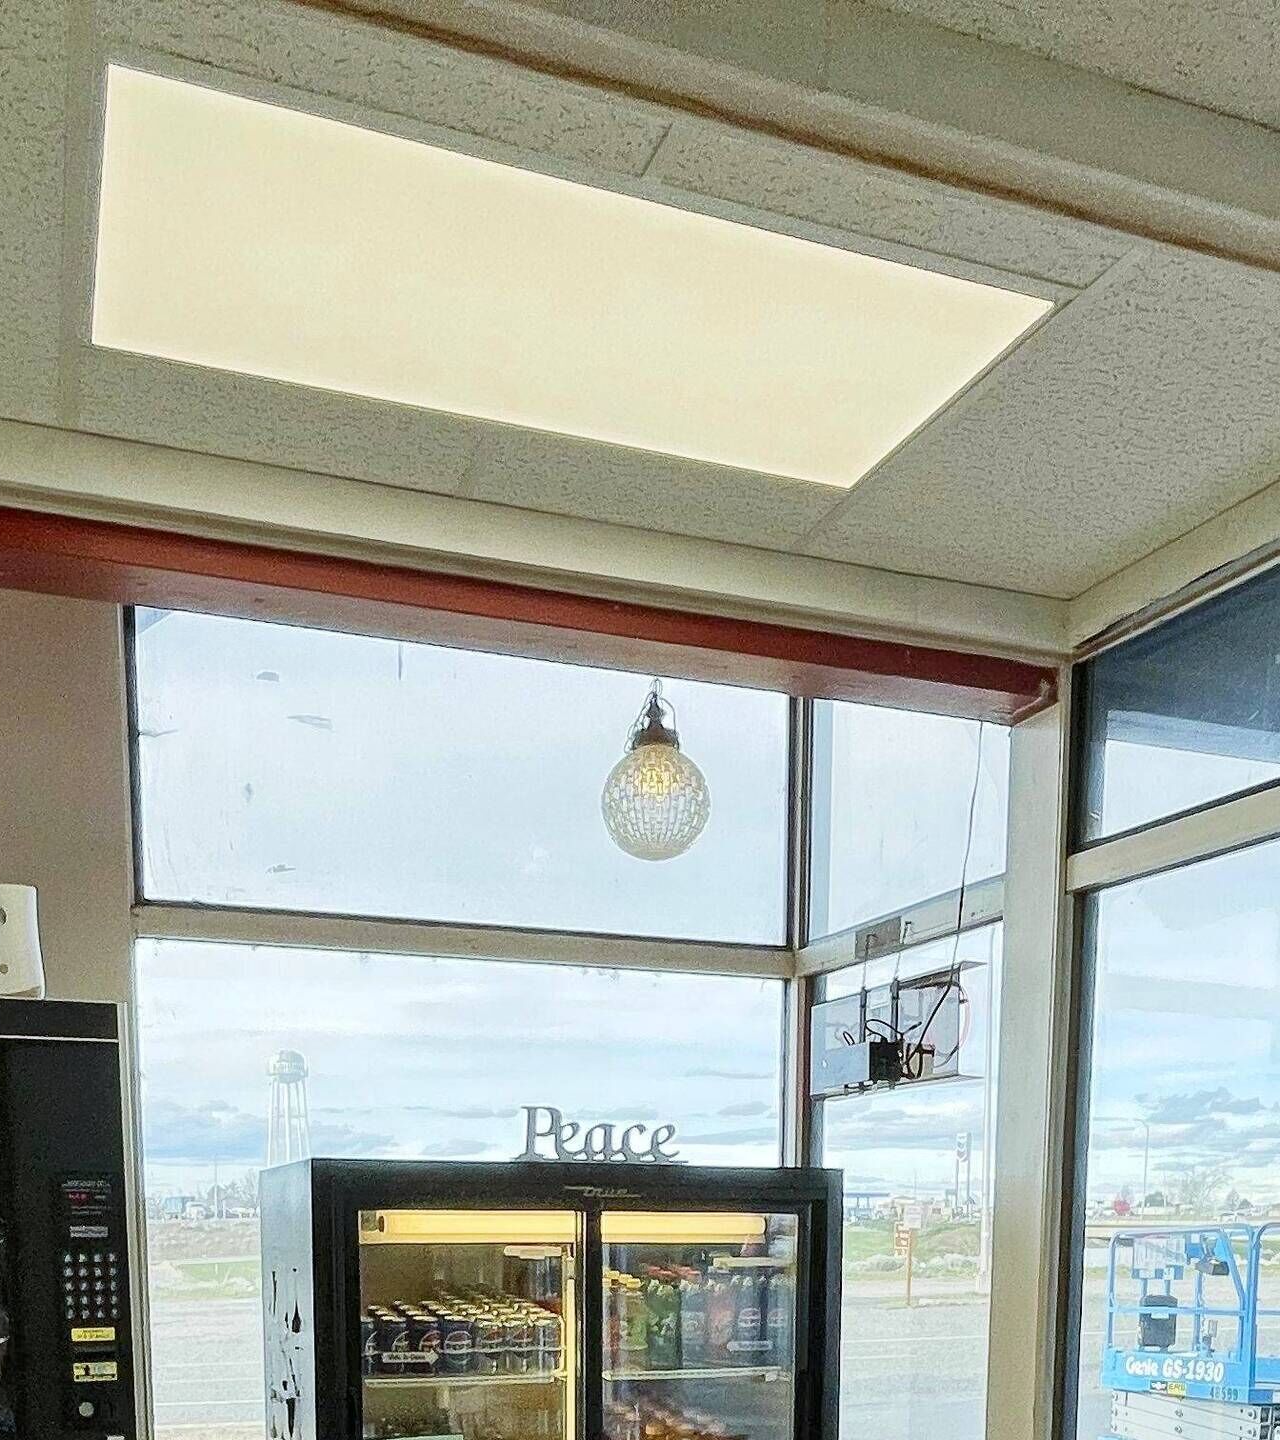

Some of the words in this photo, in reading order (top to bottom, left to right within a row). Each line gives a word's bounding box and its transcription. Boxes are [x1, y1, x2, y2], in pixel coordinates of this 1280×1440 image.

[520, 1105, 681, 1163] Peace
[1125, 1356, 1159, 1376] Genie
[1162, 1358, 1225, 1382] GS-1930
